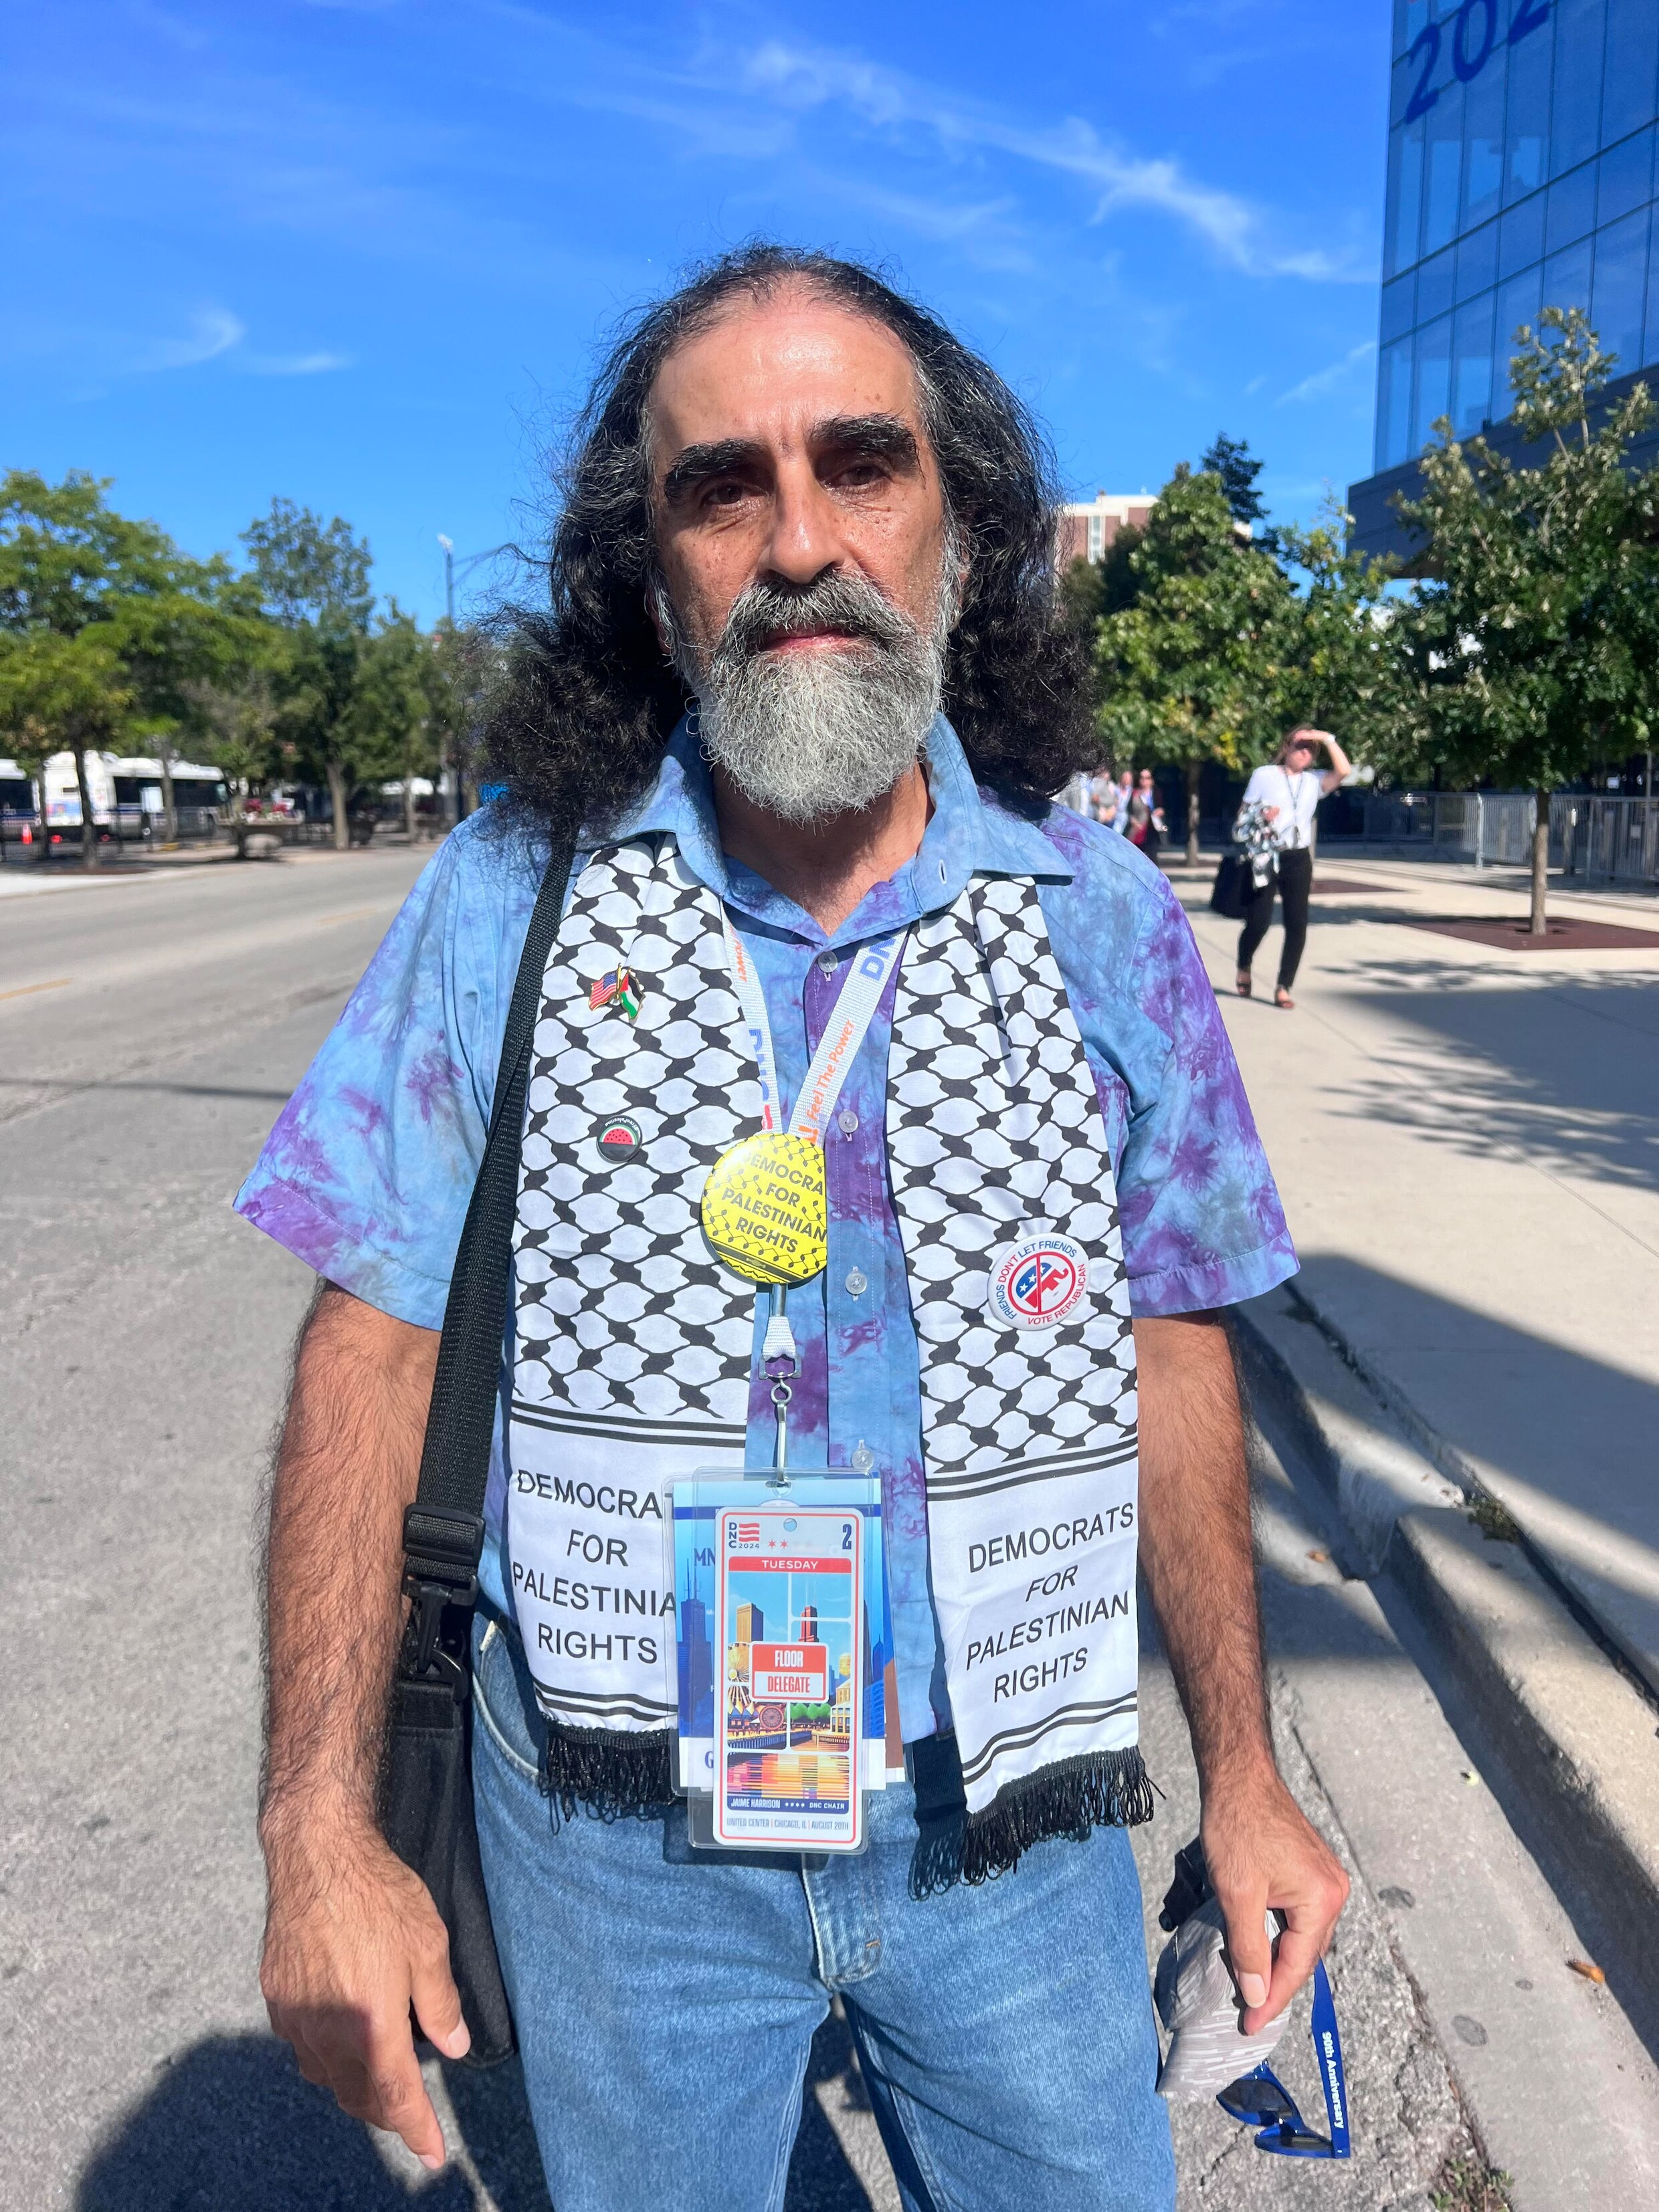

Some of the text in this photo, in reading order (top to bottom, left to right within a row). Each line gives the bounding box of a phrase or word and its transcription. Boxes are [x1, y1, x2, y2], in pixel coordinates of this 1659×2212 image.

[805, 1089, 825, 1121] Feel
[816, 1064, 836, 1088] The
[828, 1019, 856, 1064] Power
[765, 1182, 800, 1208] FOR
[721, 1187, 827, 1242] PALESTINIAN
[735, 1217, 798, 1253] RIGHTS
[995, 1240, 1077, 1320] FRIENDS DON'T LET FRIENDS
[1028, 1263, 1086, 1325] VOTE REPUBLICAN
[567, 1529, 628, 1567] FOR
[728, 1522, 737, 1548] DNC
[842, 1524, 852, 1550] 2
[969, 1502, 1134, 1573] DEMOCRATS
[762, 1560, 818, 1570] TUESDAY
[1025, 1565, 1078, 1603] FOR
[539, 1622, 658, 1664] RIGHTS
[966, 1590, 1129, 1671] PALESTINIAN
[774, 1649, 803, 1668] FLOOR
[994, 1647, 1088, 1703] RIGHTS
[767, 1676, 810, 1693] DELEGATE
[730, 1798, 781, 1809] JAIME HARRISON
[726, 1817, 849, 1830] UNITED CENTER CHICAGO, IL AUGUST 20TH
[1322, 2031, 1345, 2129] 90th Anniversary
